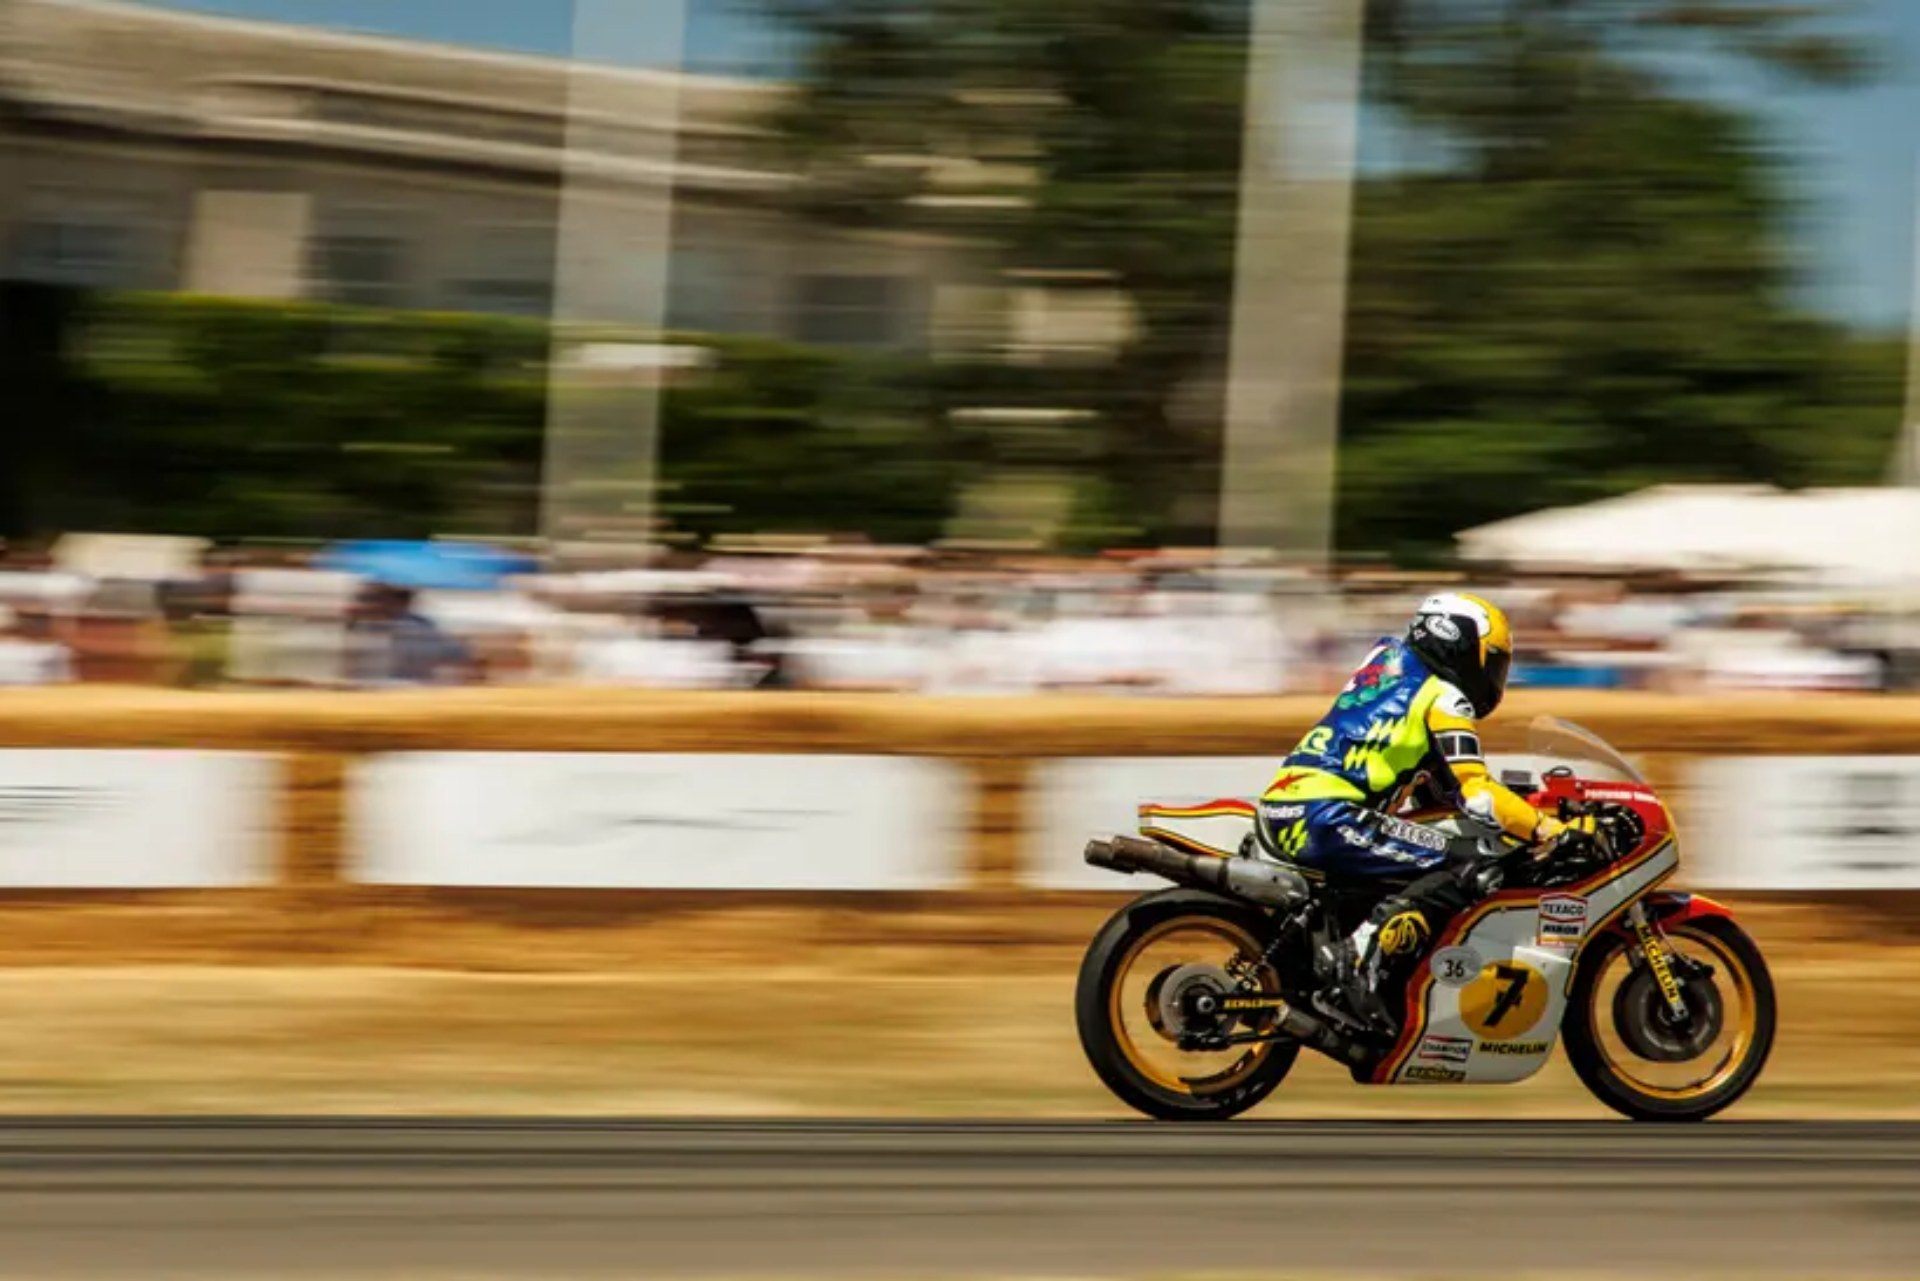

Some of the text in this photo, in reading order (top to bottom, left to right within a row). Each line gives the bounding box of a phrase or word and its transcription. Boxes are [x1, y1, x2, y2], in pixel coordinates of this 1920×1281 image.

[1542, 902, 1584, 916] TEXACO
[1444, 959, 1465, 978] 36
[1639, 925, 1678, 998] MICHELIN
[1482, 964, 1530, 1027] 7
[1421, 1041, 1468, 1055] CHAMPION
[1479, 1041, 1549, 1055] MICHELIN
